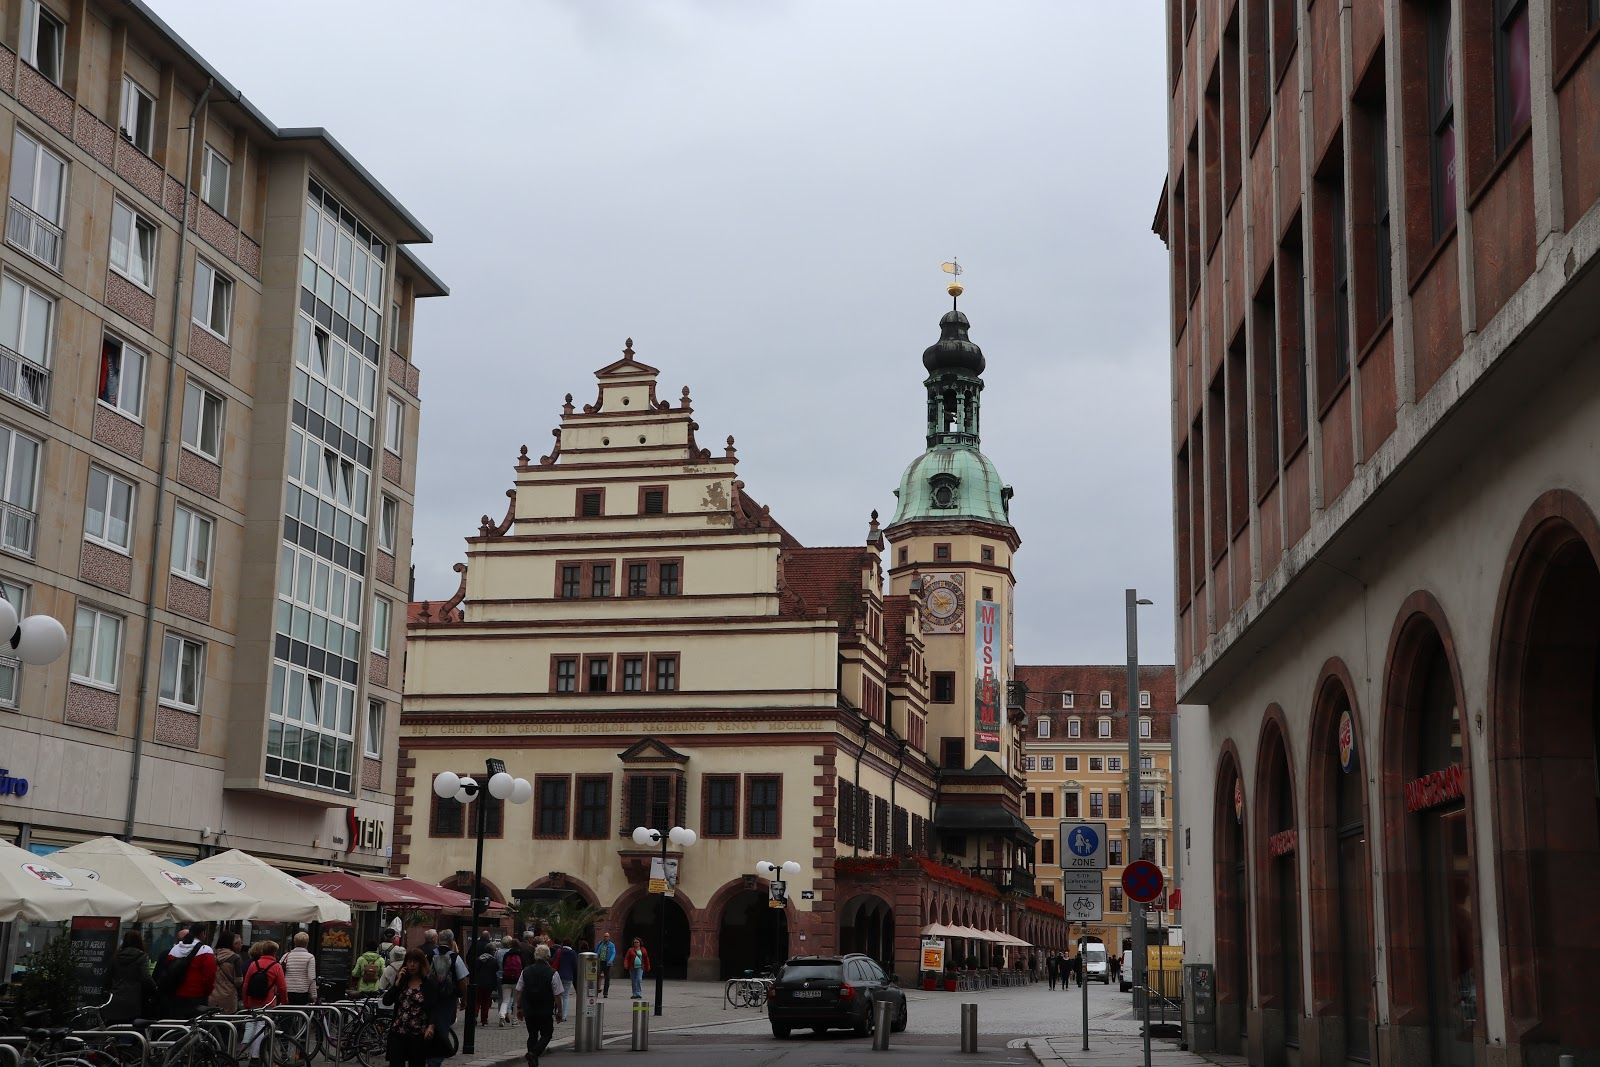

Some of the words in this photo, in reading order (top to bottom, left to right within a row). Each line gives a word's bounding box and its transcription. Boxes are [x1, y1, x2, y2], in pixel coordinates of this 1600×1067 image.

[980, 605, 995, 723] MUSEUM
[642, 722, 705, 732] REGIERUNG
[1072, 858, 1096, 867] ZONE
